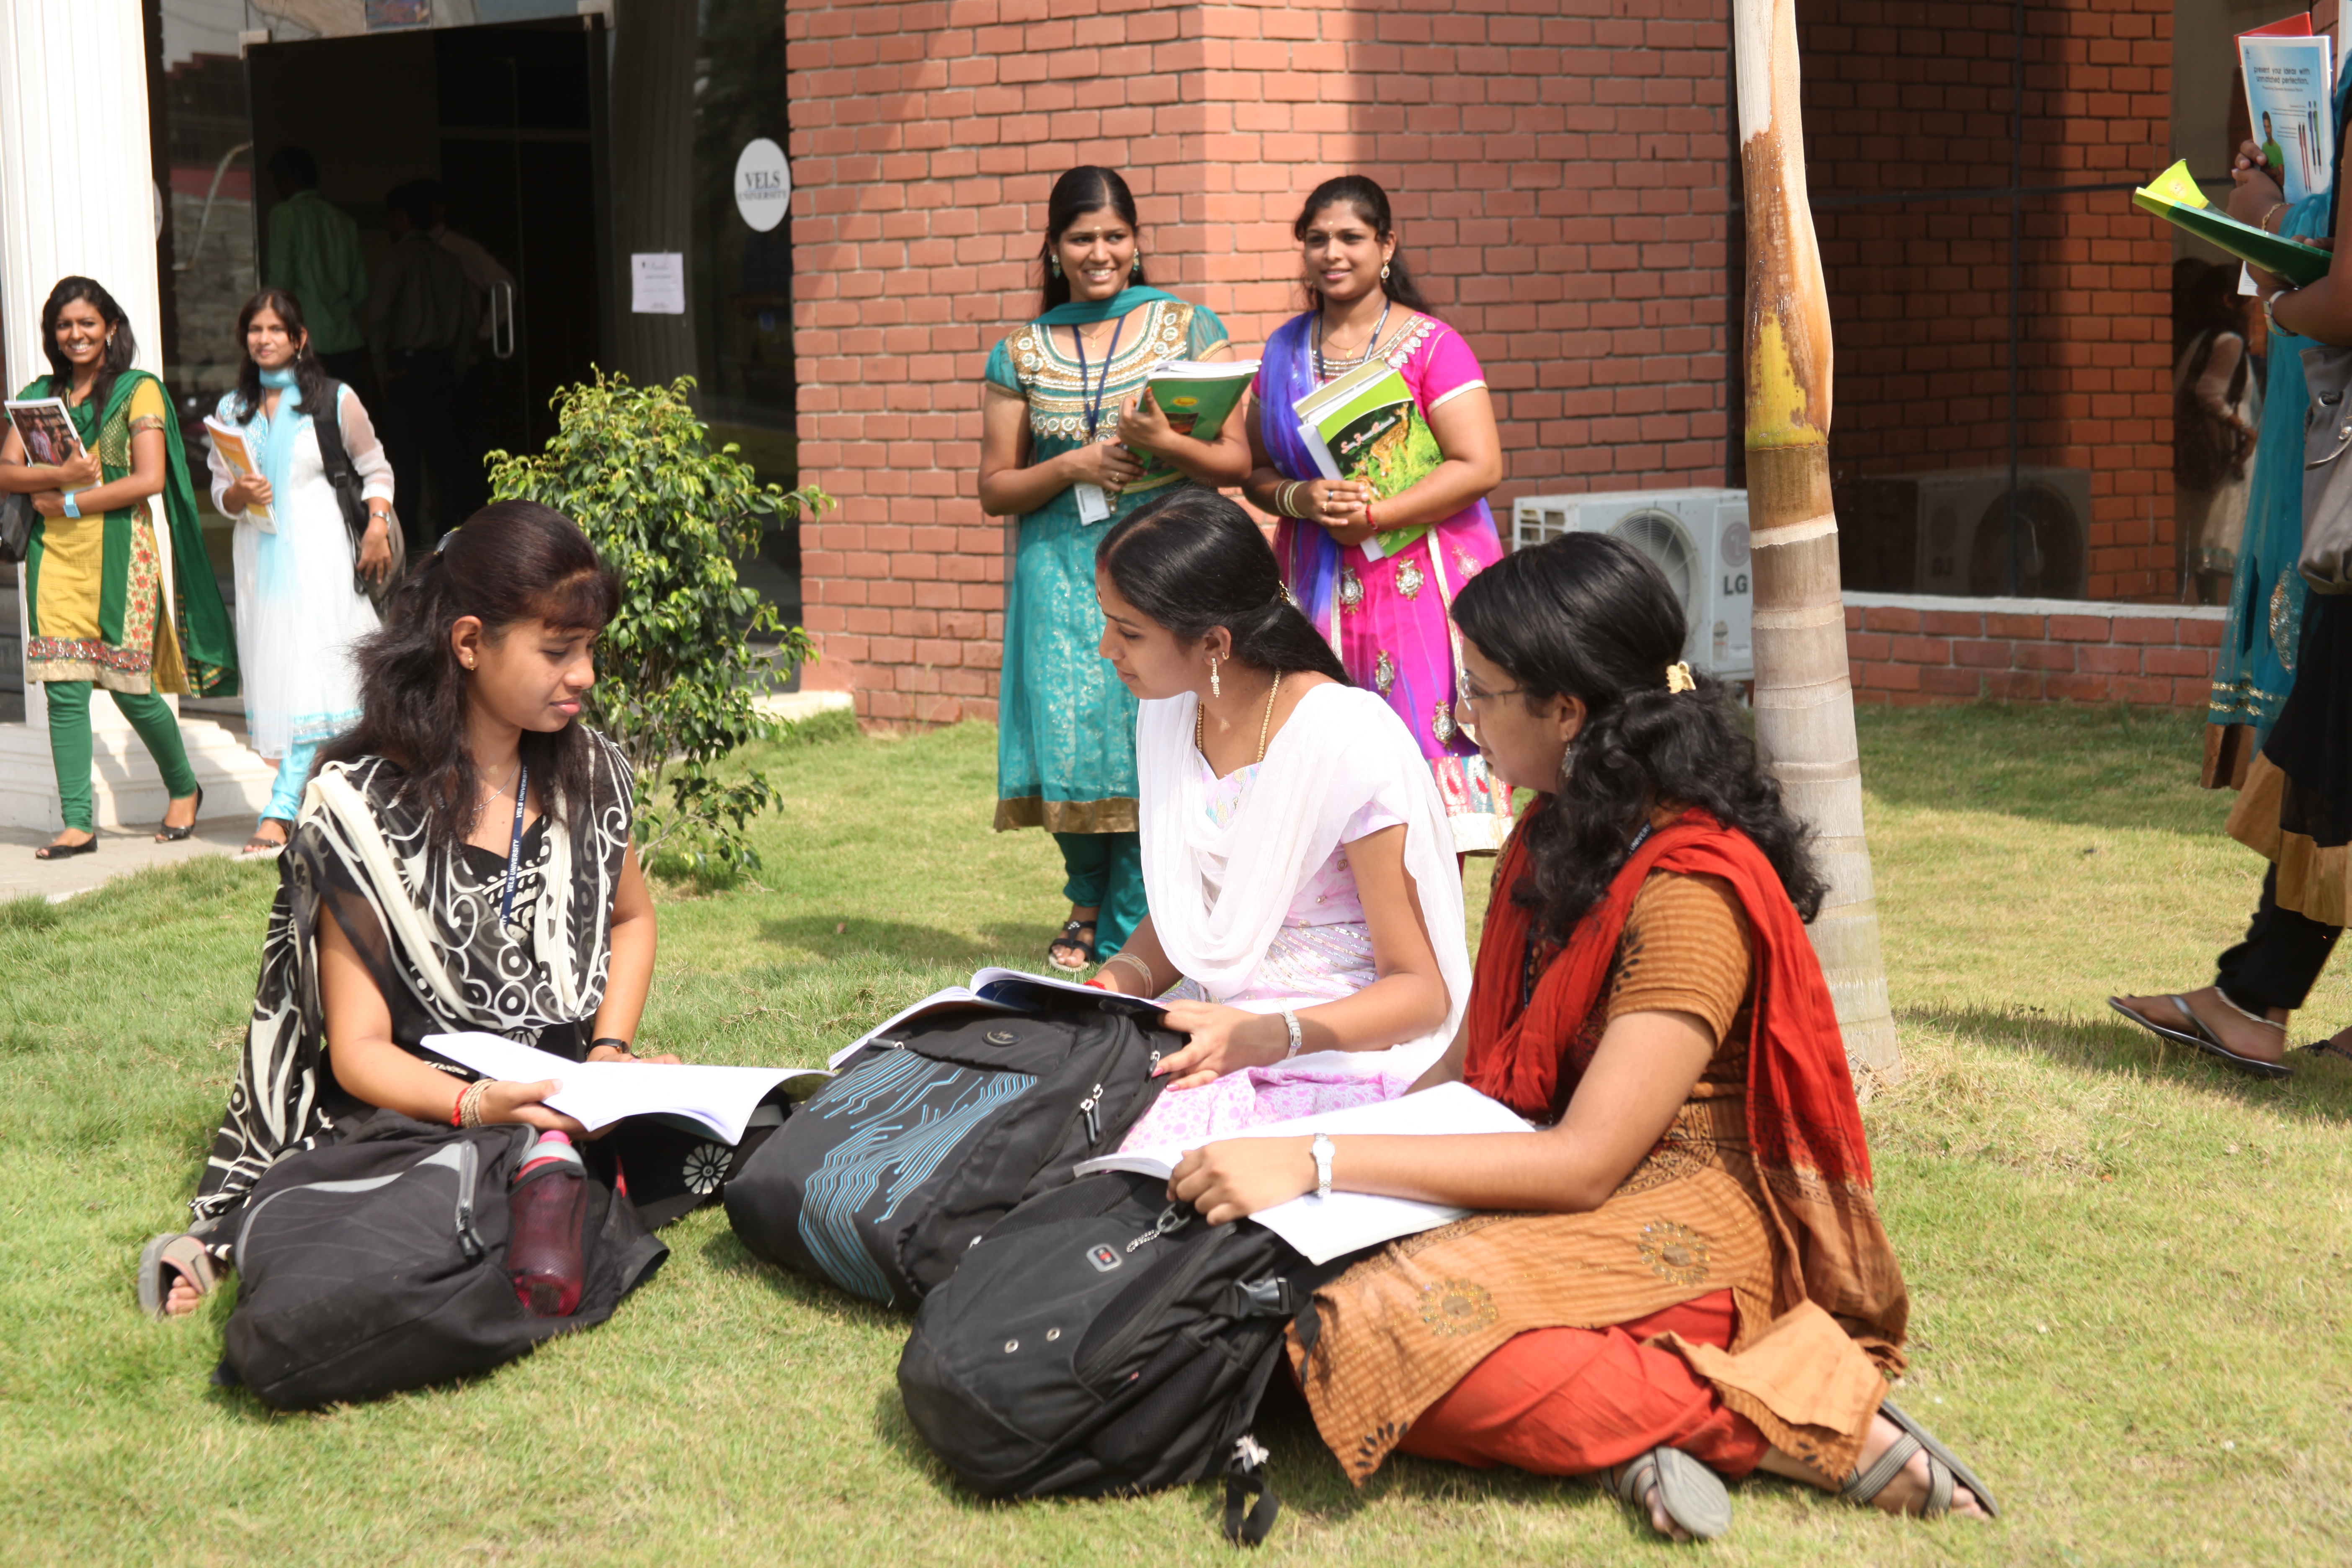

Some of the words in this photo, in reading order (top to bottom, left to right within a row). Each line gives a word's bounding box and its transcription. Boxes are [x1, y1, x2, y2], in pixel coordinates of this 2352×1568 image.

[745, 170, 781, 188] VELS
[738, 190, 787, 201] UNIVERSITY
[1724, 574, 1748, 595] LG
[518, 765, 528, 801] UNIVERSITY
[1629, 823, 1651, 851] UNIVERS
[510, 839, 519, 875] UNIVERSITY
[506, 876, 515, 892] VELS
